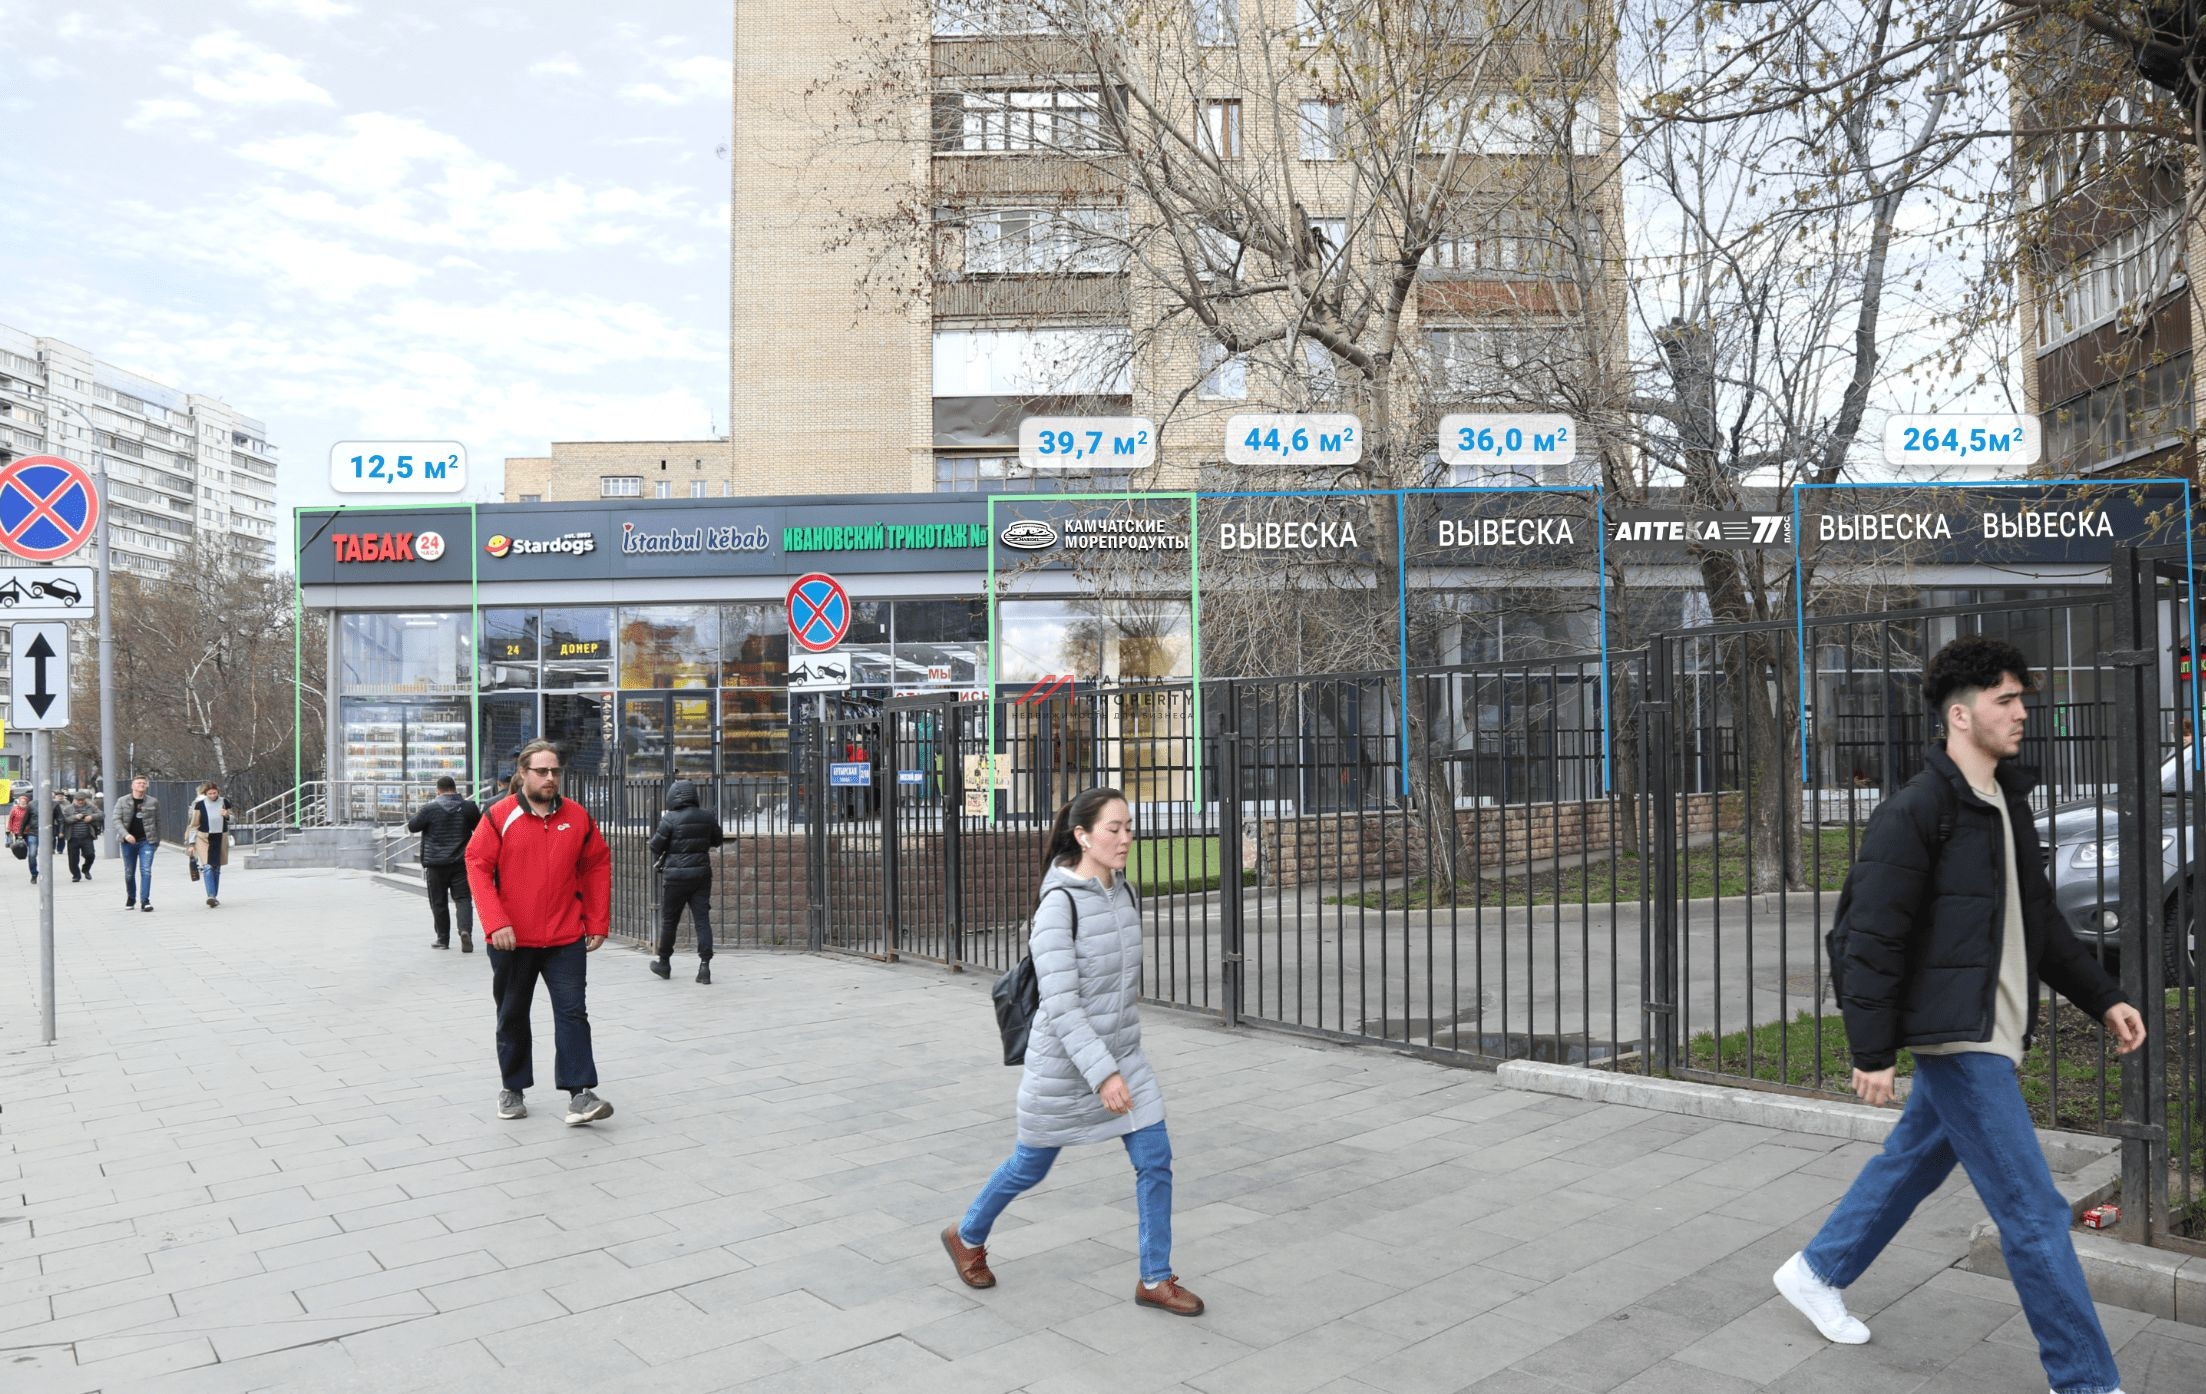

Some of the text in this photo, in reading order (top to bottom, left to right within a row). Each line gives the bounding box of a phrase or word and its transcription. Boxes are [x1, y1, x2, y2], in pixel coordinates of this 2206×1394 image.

[1065, 519, 1165, 533] КАМЧАТСКИЕ
[1614, 521, 1722, 541] АПТЕКА
[1751, 516, 1784, 544] 77
[421, 536, 439, 549] 24
[783, 521, 884, 551] ИВАНОВСКИЙ
[887, 523, 968, 549] ТРИКОТАЖ
[1065, 535, 1189, 551] МОРЕПРОДУКТЫ
[331, 532, 415, 562] ТАБАК
[512, 537, 594, 556] Stardogs
[507, 645, 520, 655] 24
[560, 643, 599, 655] ДОНЕР
[928, 668, 951, 680] МЫ
